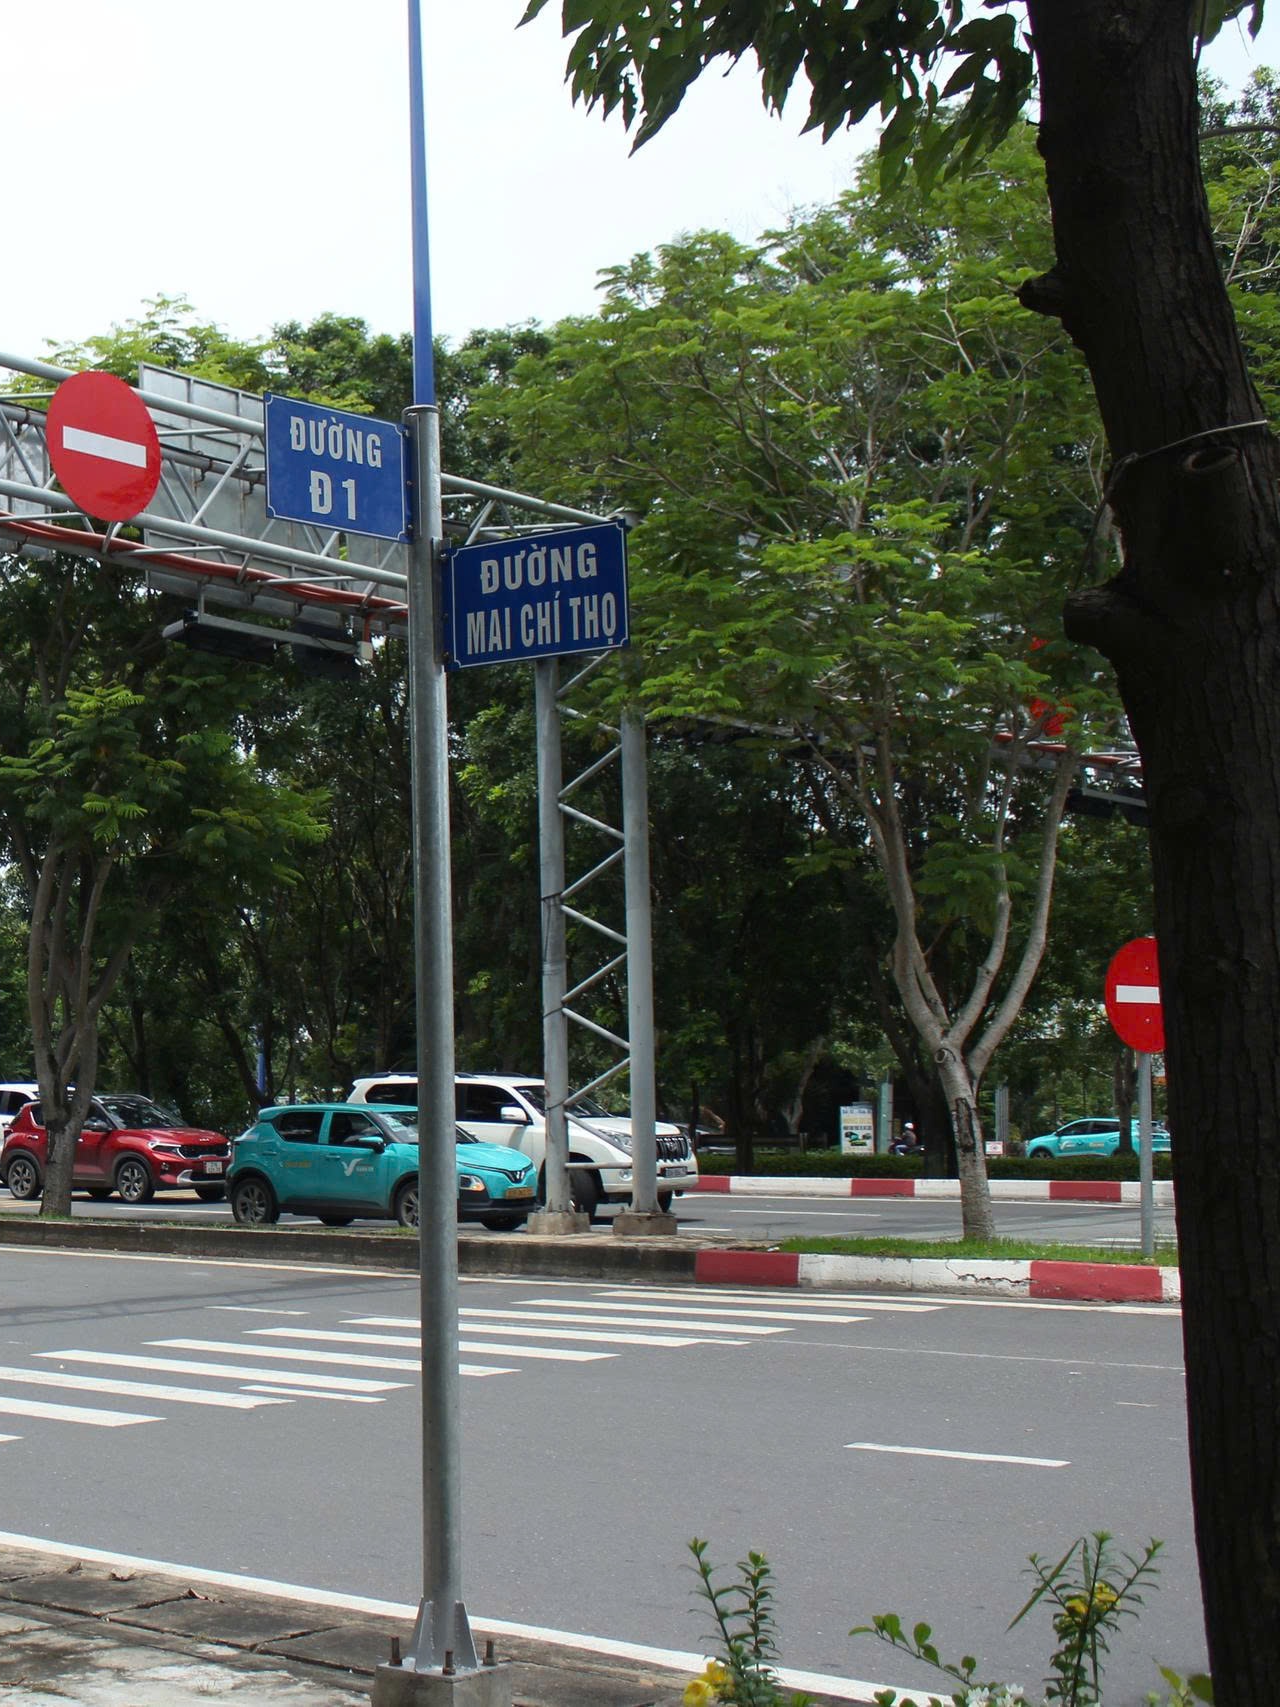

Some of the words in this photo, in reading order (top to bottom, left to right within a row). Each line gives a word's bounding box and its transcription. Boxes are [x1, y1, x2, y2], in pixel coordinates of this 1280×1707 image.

[290, 416, 382, 468] ĐƯỜNG
[480, 542, 598, 595] ĐƯỜNG
[467, 608, 512, 656] MAI
[520, 591, 561, 648] CHÍ
[569, 592, 617, 646] THỌ
